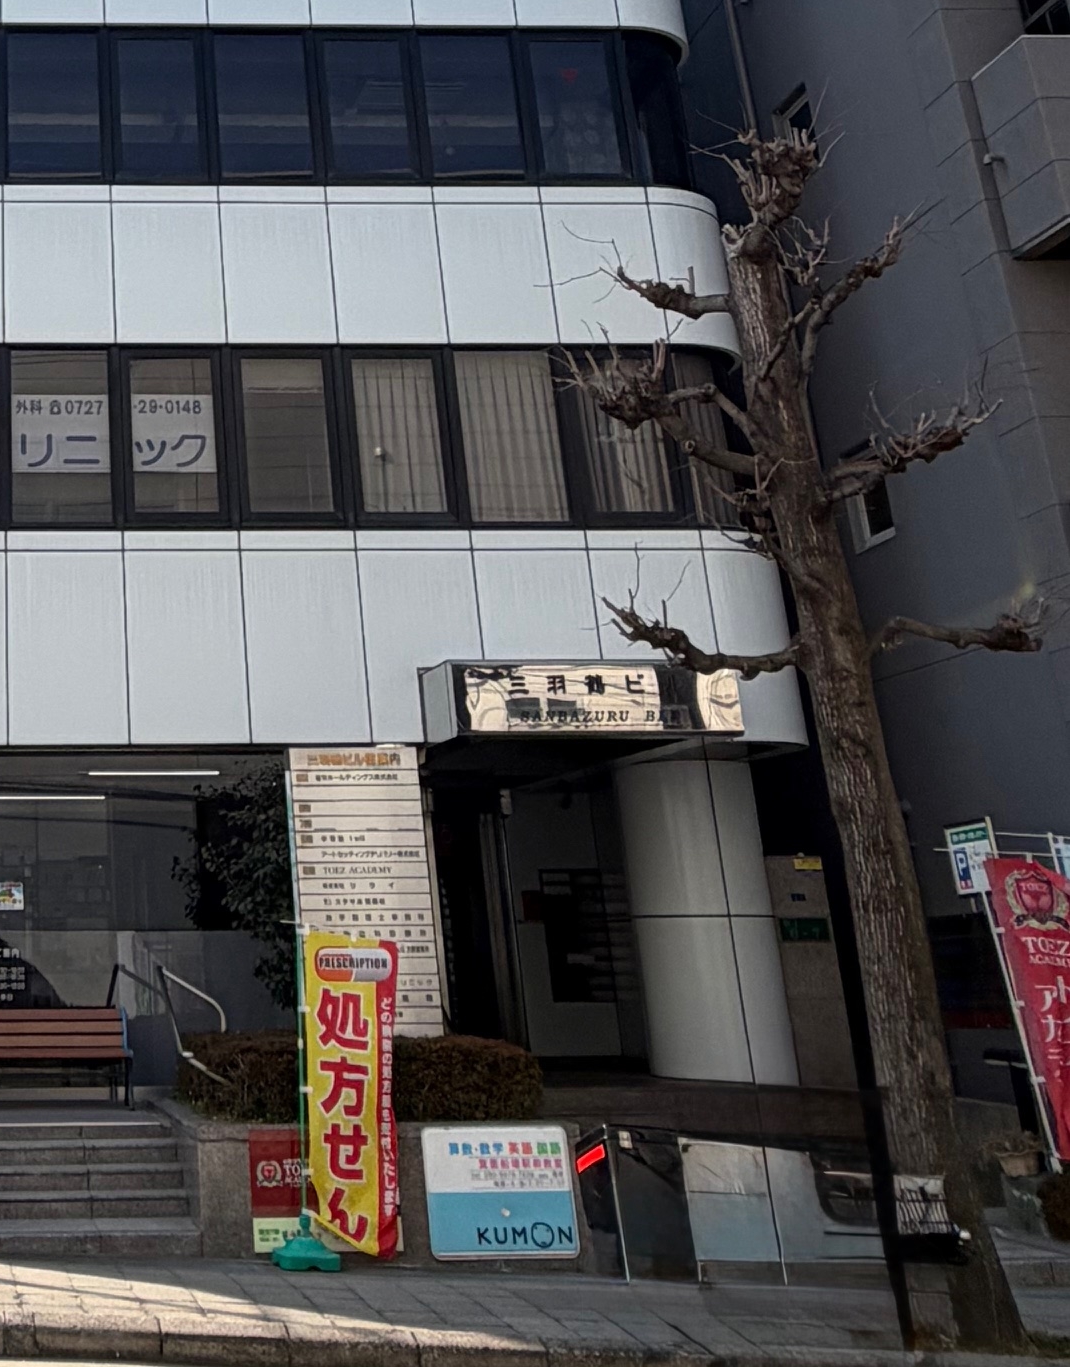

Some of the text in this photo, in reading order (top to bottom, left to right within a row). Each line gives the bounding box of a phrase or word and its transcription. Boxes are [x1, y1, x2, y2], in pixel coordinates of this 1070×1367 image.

[16, 399, 42, 415] 外科
[319, 957, 388, 969] PRESCRIPTION
[316, 988, 369, 1244] 処方せん
[476, 1222, 574, 1249] KUMON
